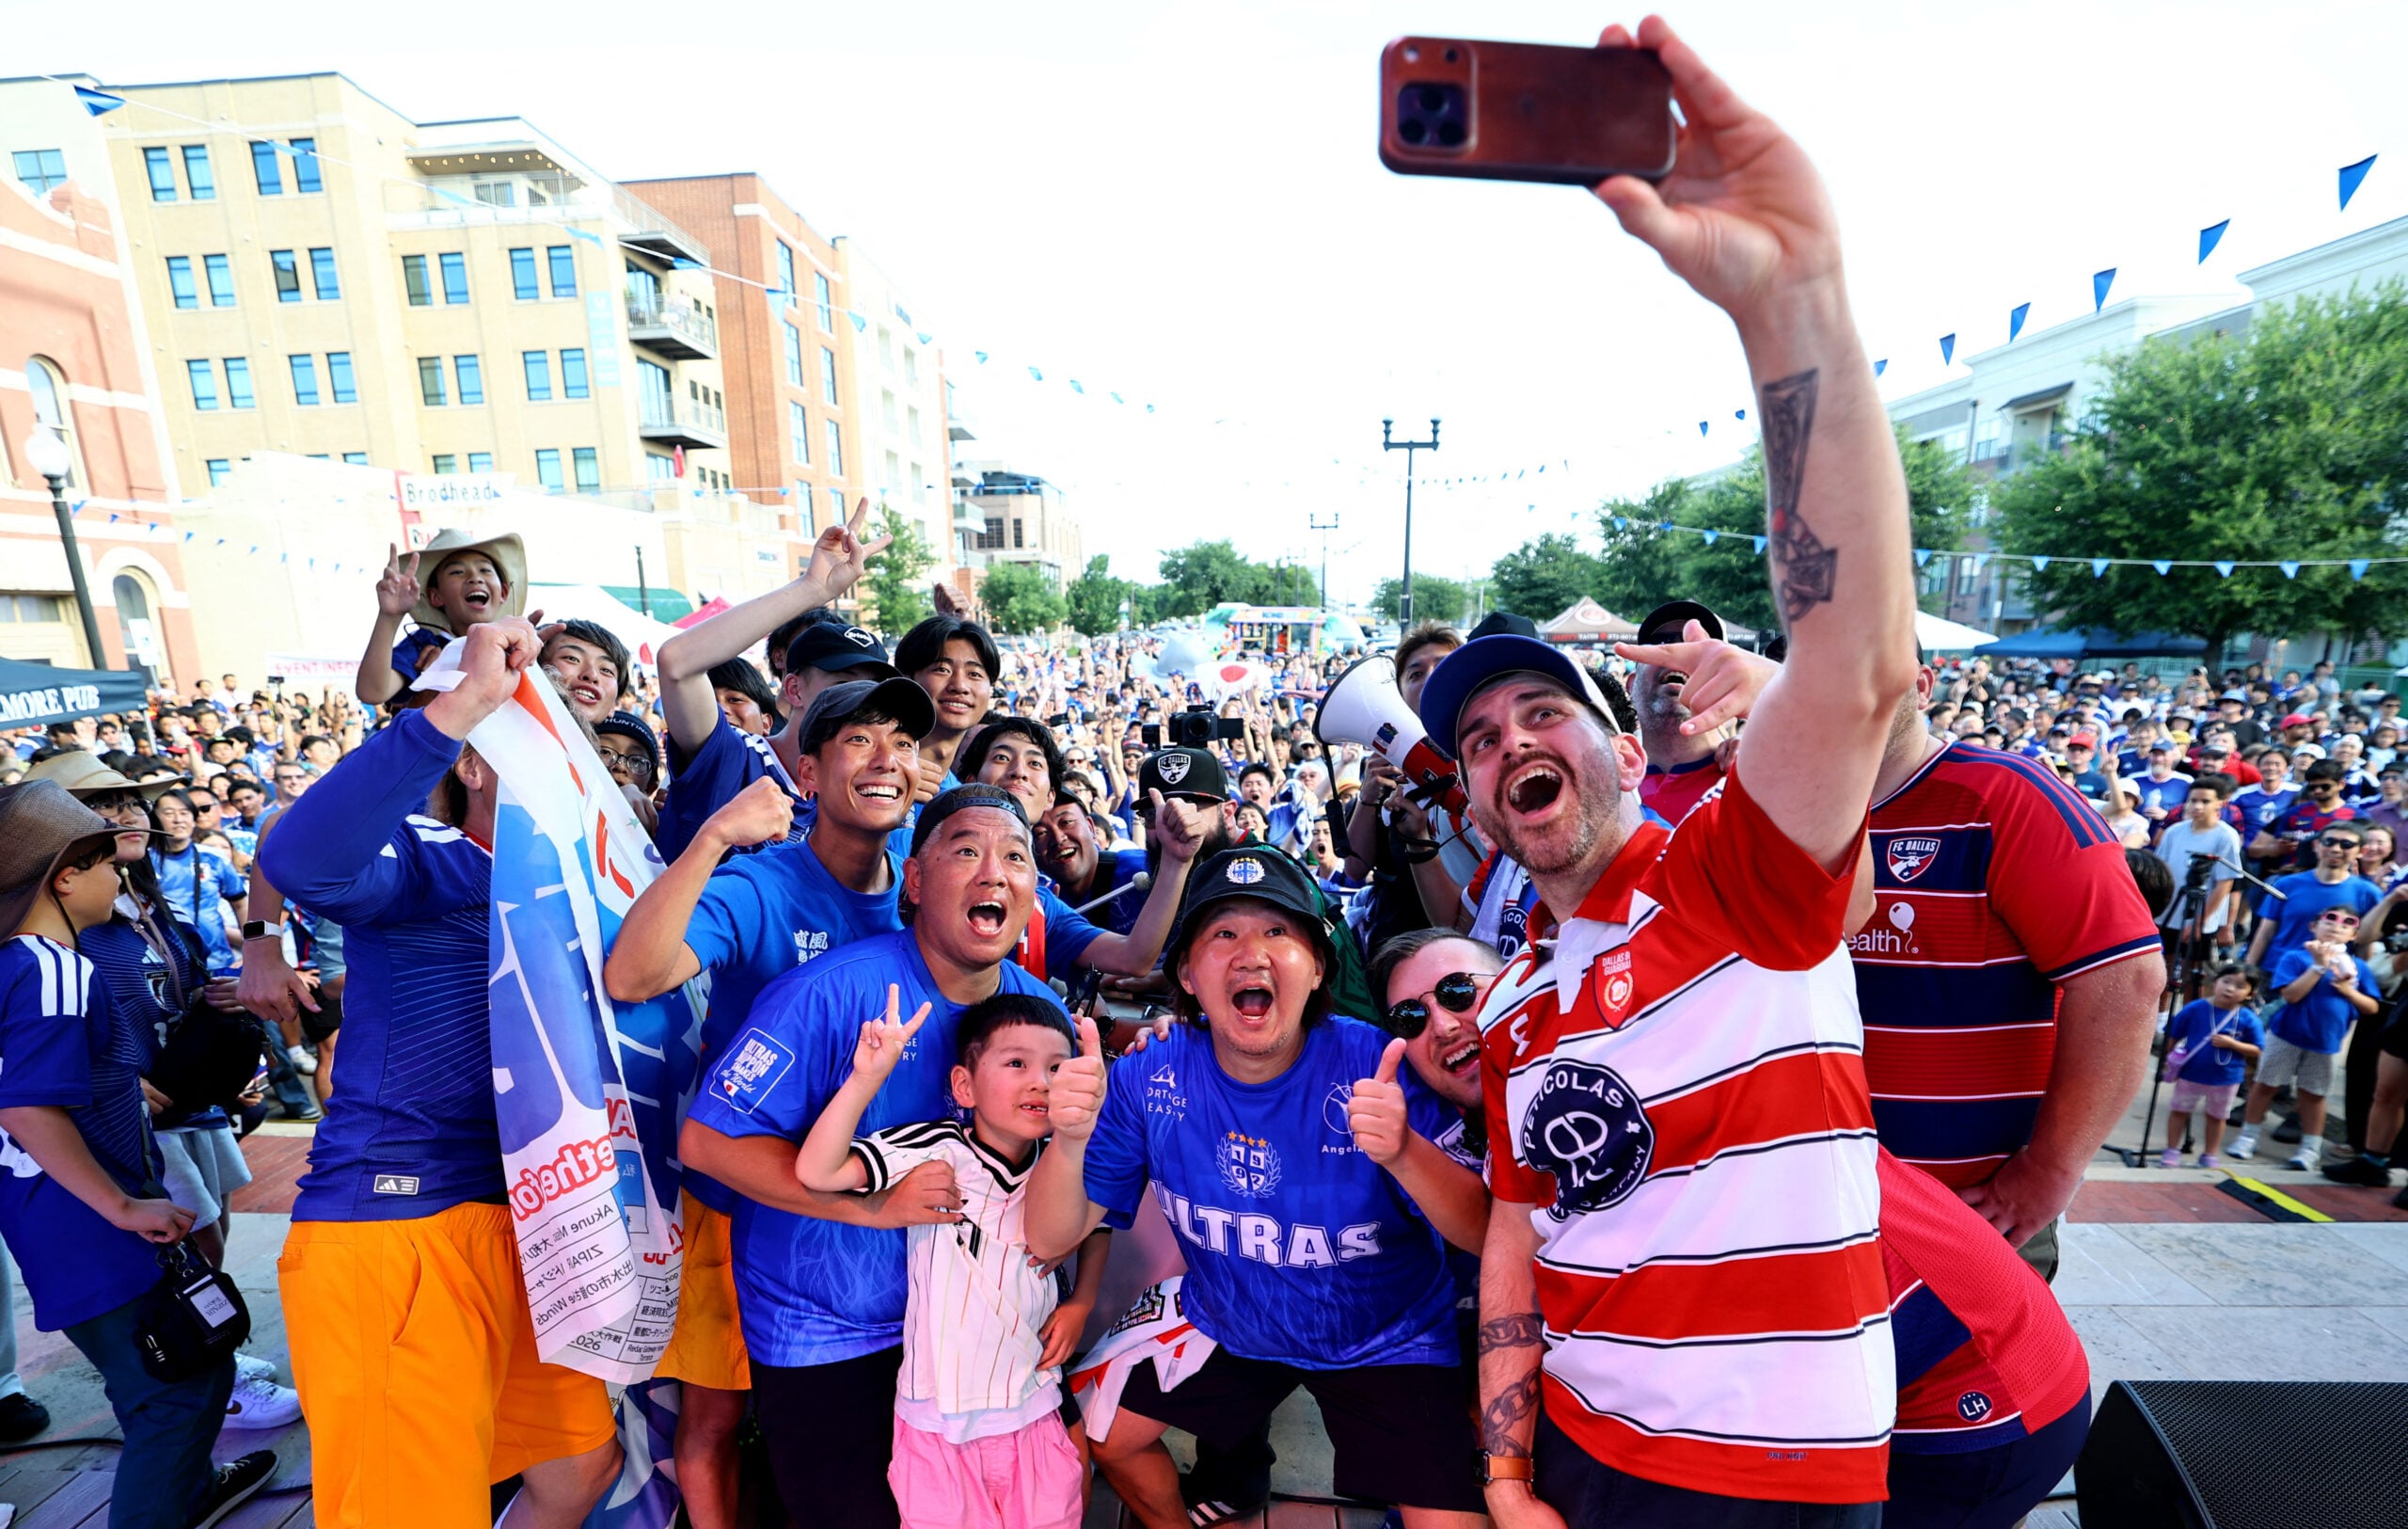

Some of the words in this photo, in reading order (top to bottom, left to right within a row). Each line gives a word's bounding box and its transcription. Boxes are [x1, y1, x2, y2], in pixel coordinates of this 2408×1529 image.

[406, 481, 492, 502] Brodhead
[324, 661, 360, 674] INFO
[61, 685, 100, 712] PUB
[1168, 756, 1187, 764] DALLAS
[1893, 841, 1904, 852] FC
[1906, 840, 1936, 852] DALLAS
[1503, 912, 1527, 933] ICOL
[1602, 952, 1624, 967] DALLAS
[744, 1039, 778, 1066] ULTRAS
[1524, 1070, 1624, 1149] PETICOLAS
[570, 1334, 601, 1351] 026
[1962, 1397, 1988, 1417] LH
